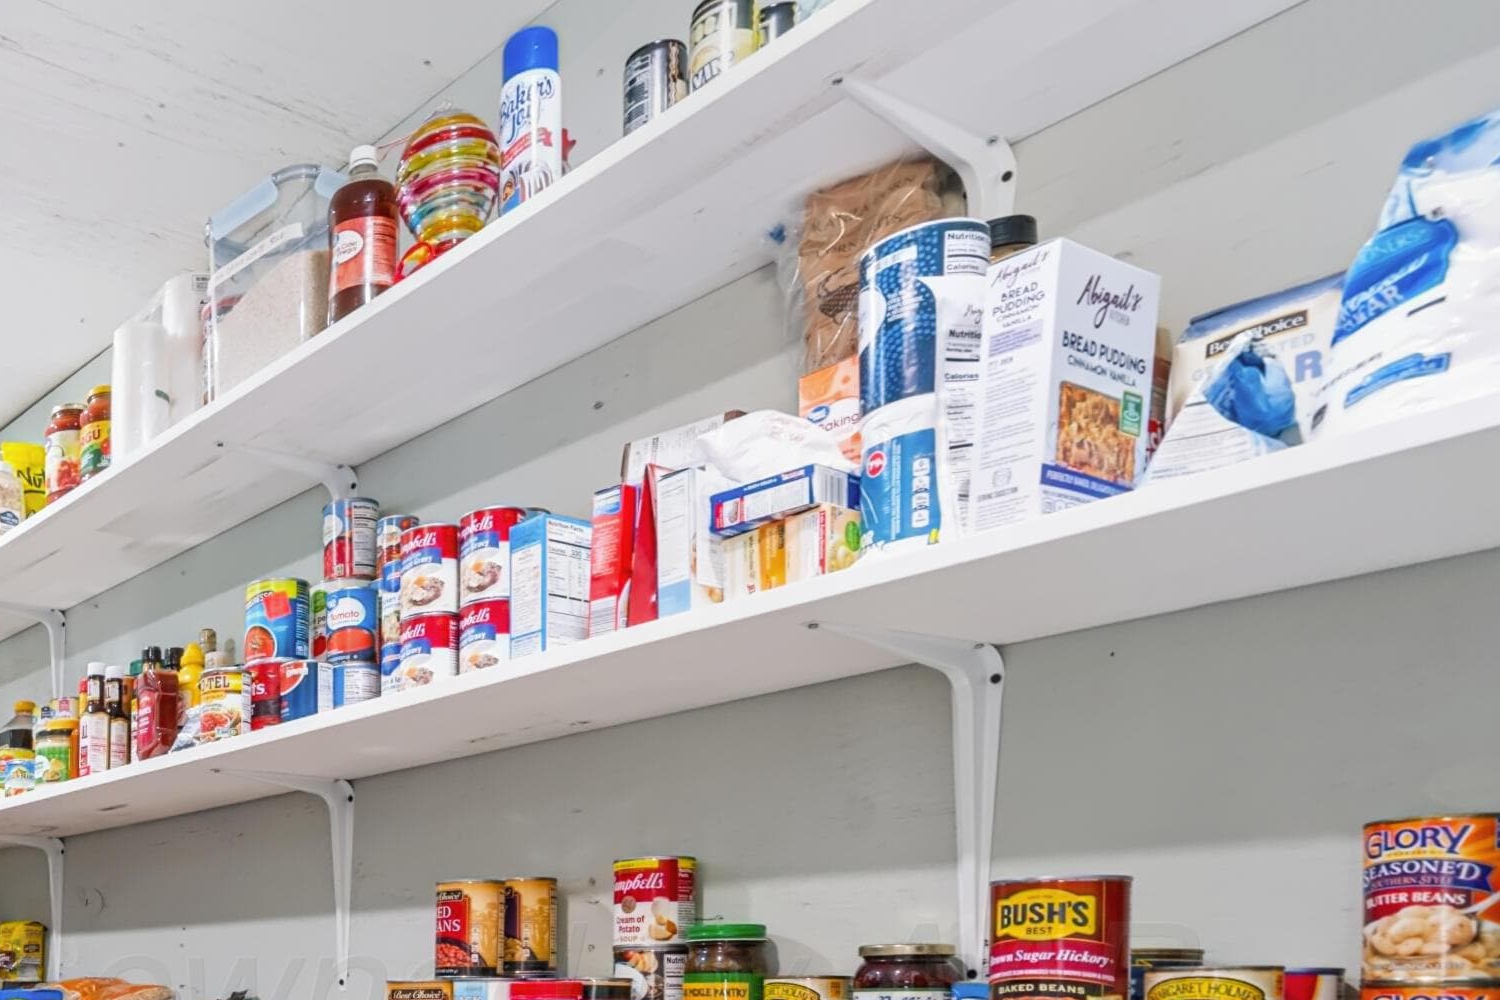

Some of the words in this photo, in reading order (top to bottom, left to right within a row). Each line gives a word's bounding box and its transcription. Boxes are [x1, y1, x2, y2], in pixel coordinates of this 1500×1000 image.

[1000, 282, 1038, 302] BREAD
[1076, 275, 1143, 328] Abigail's
[992, 291, 1045, 317] PUDDING
[1062, 331, 1097, 357] BREAD
[1099, 345, 1146, 374] PUDDING
[1366, 823, 1474, 860] GLORY
[1363, 859, 1482, 887] SEASONED
[1411, 891, 1468, 905] BEANS
[636, 915, 645, 925] of
[1000, 901, 1089, 930] BUSH'S
[618, 925, 641, 935] Potato
[1025, 926, 1053, 935] BEST
[1015, 949, 1054, 963] Sugar
[1056, 949, 1109, 968] Hickory
[411, 990, 442, 1000] Choice
[999, 984, 1036, 995] BAKED
[1039, 984, 1085, 995] BEANS
